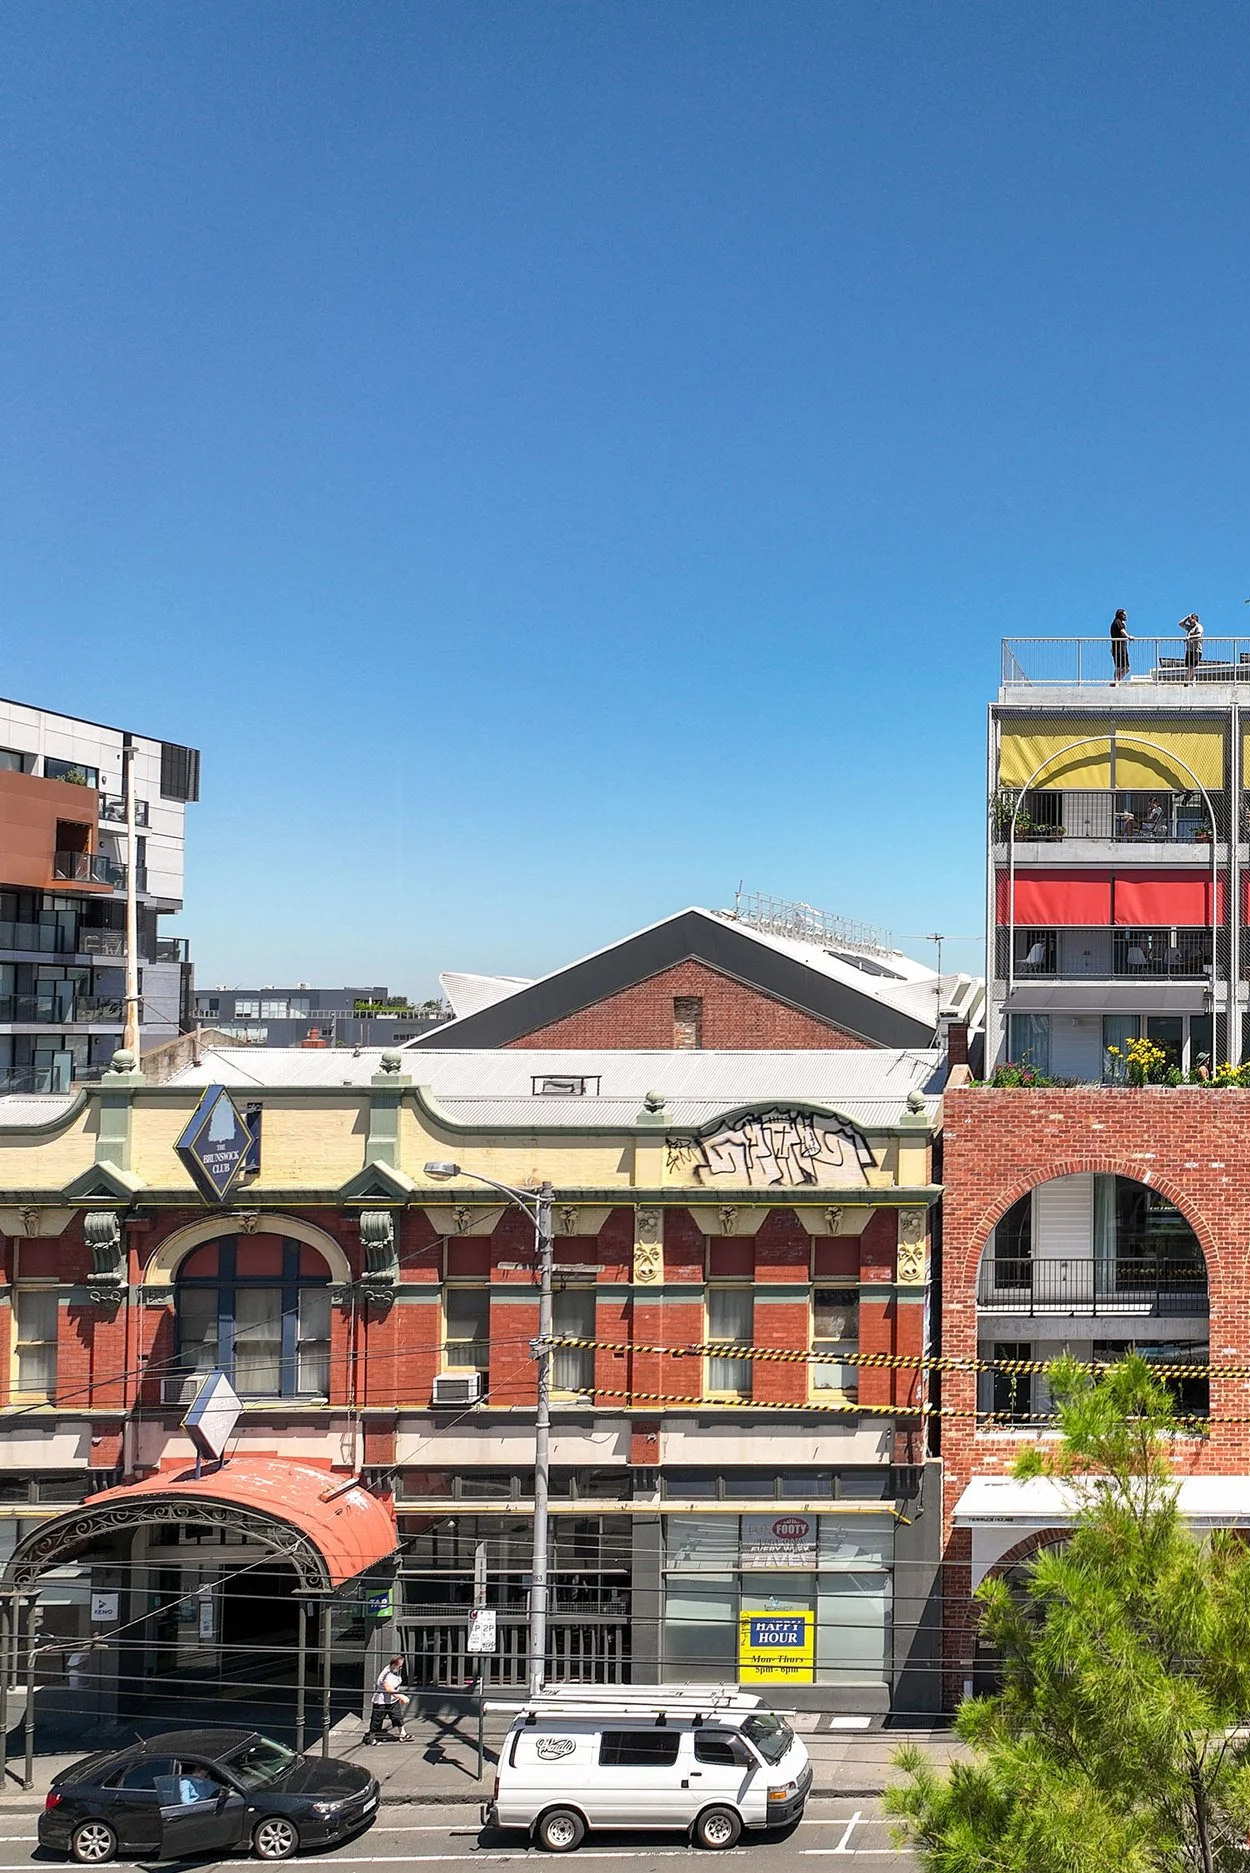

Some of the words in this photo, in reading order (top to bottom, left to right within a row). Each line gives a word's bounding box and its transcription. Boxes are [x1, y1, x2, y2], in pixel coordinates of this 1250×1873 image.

[203, 1151, 239, 1164] BRUNSWICK
[212, 1164, 230, 1174] CLUB
[776, 1524, 807, 1534] FOOTY
[369, 1599, 388, 1608] TAB
[756, 1620, 801, 1631] HAPPY
[759, 1633, 797, 1643] HOUR
[778, 1655, 804, 1663] Thurs
[755, 1667, 773, 1675] 5pm
[781, 1667, 799, 1675] 6pm
